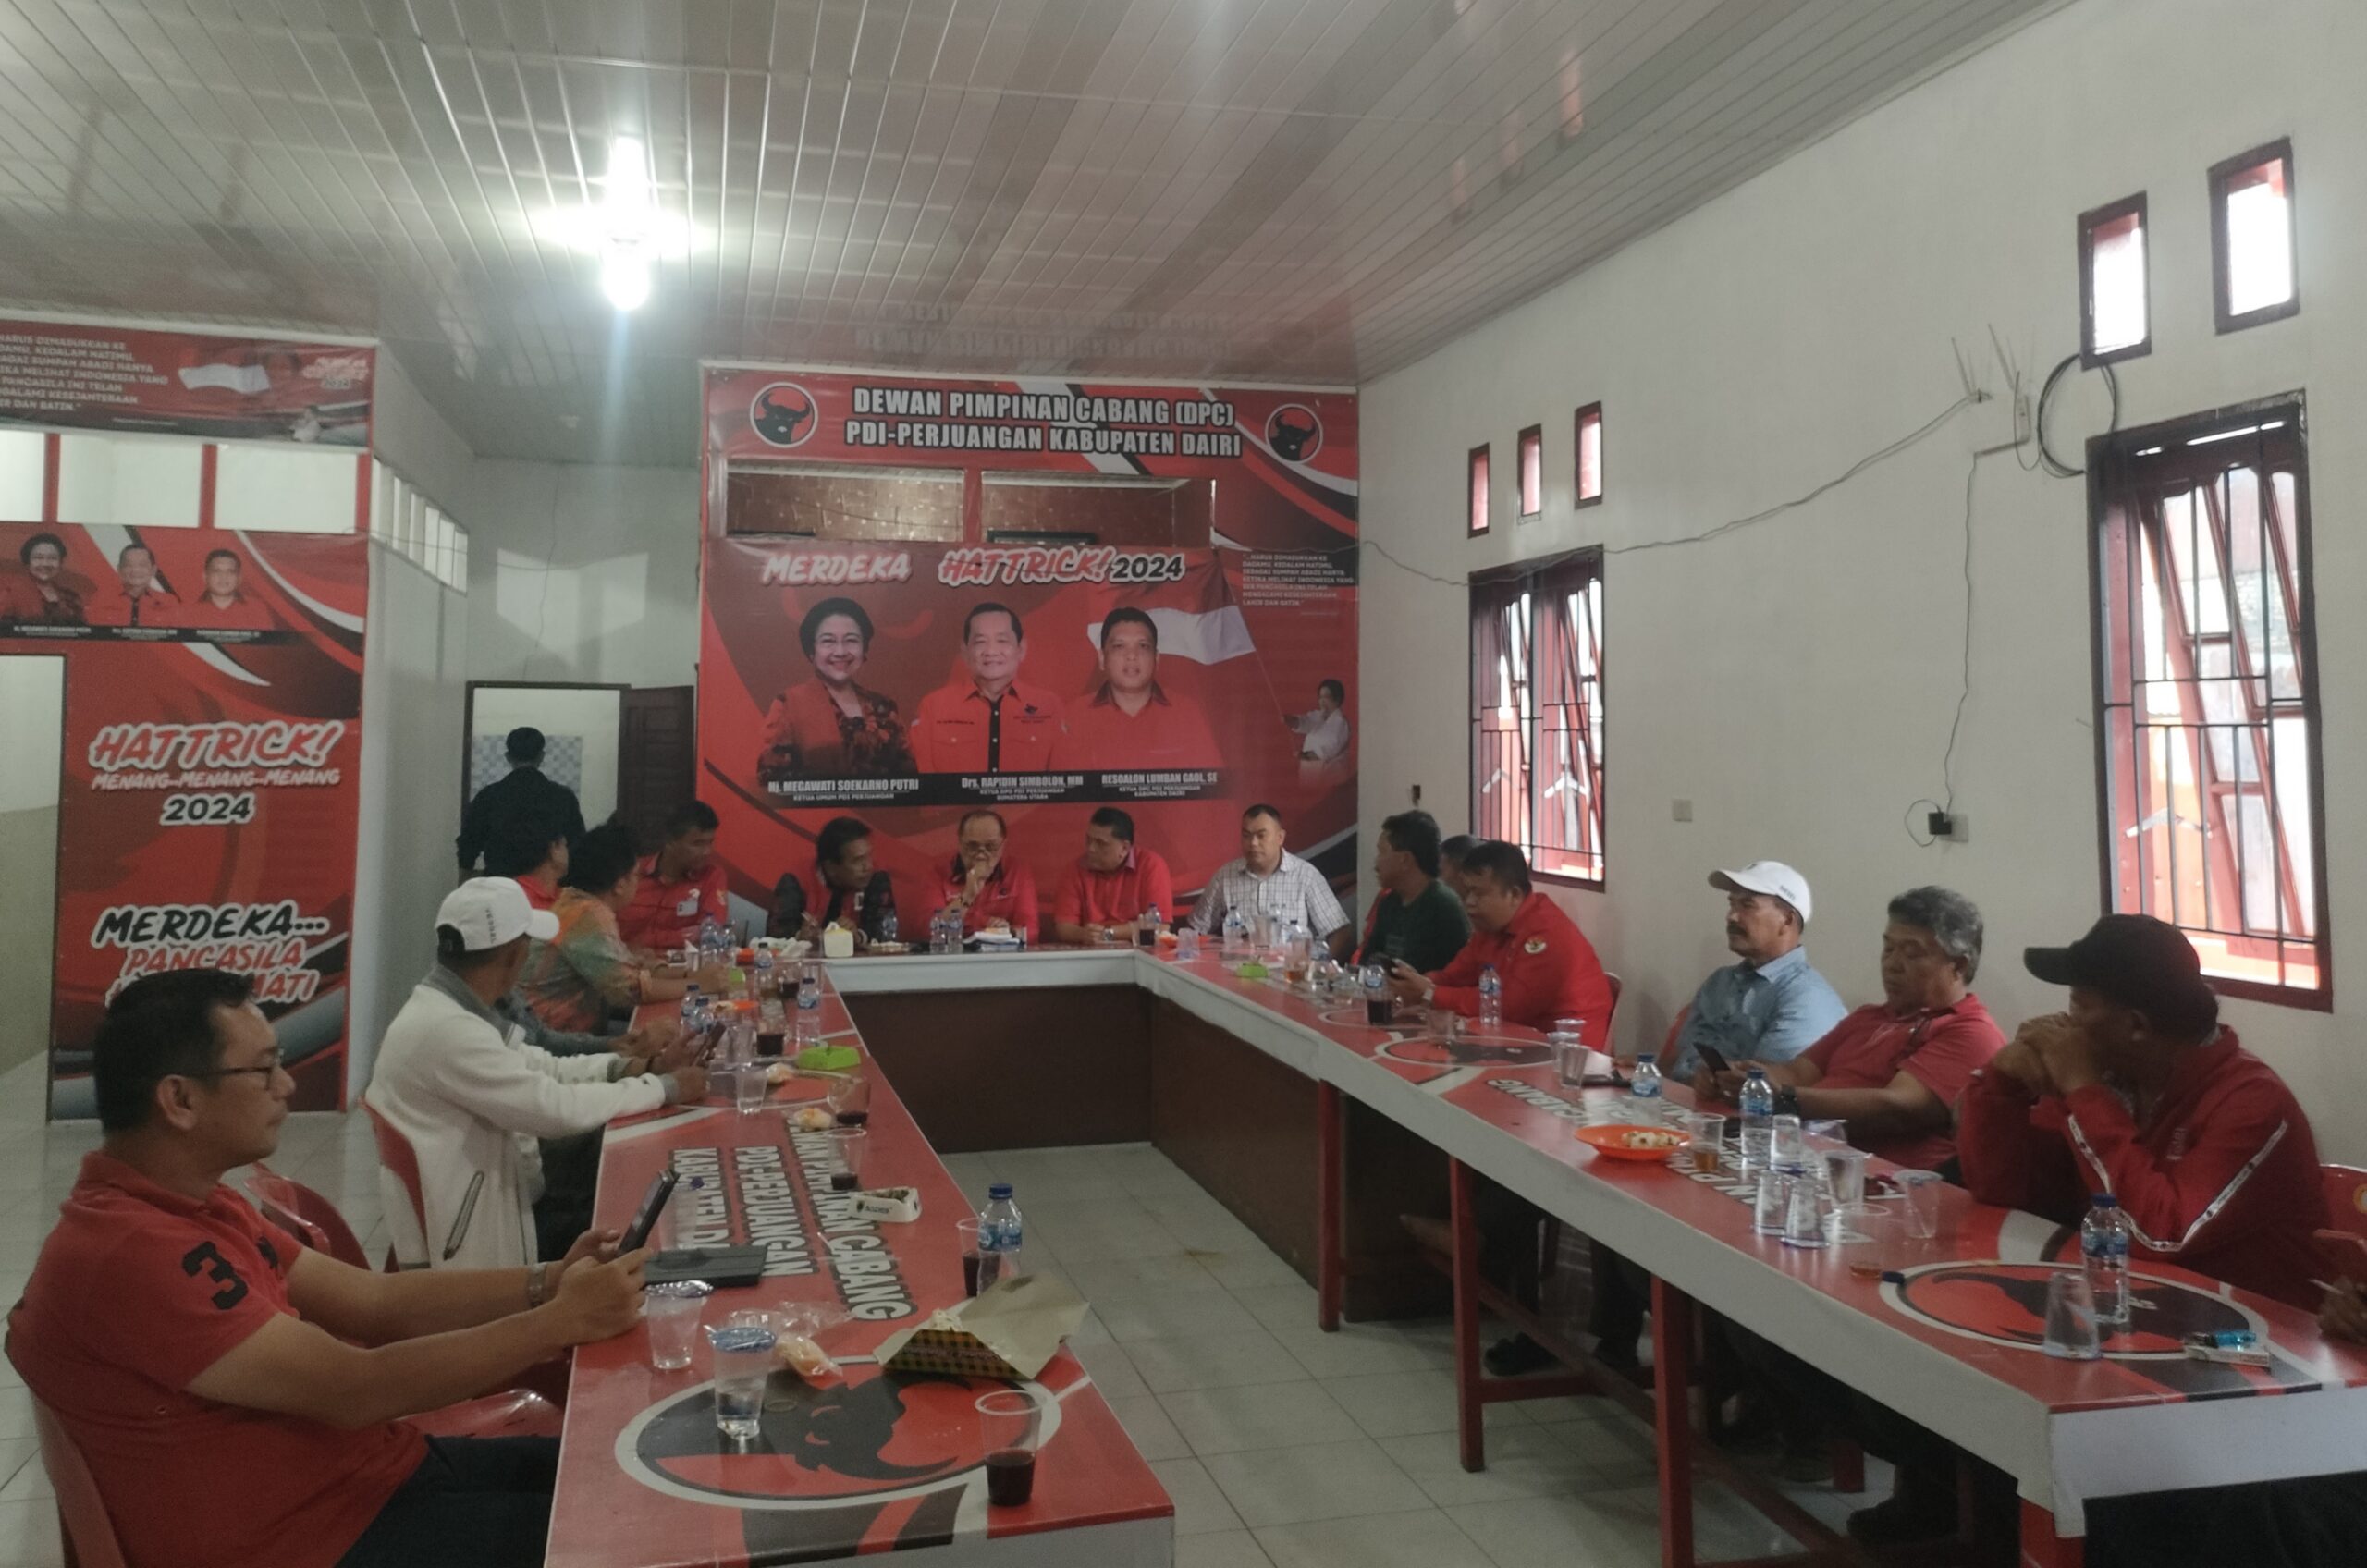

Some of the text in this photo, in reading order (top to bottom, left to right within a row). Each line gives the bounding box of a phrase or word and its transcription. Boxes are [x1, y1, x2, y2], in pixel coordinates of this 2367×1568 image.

[73, 370, 136, 382] INDONESIA
[853, 387, 1234, 427] DEWAN PIMPINAN CABANG (DPC)
[846, 420, 1241, 457] PDI-PERJUANGAN KABUPATEN DAIRI
[761, 553, 912, 585] MERDEKA
[938, 546, 1184, 586] HATTRICK! 2024
[89, 720, 345, 771] HATTRICK!
[783, 780, 836, 792] MEGAWATI
[837, 779, 889, 791] SOEKARNO
[889, 778, 919, 790] PUTRI
[981, 777, 1017, 787] RAPIDIN
[161, 793, 255, 825] 2024
[92, 900, 330, 949] MERDEKA...
[120, 937, 307, 978] PANCASILA
[181, 1241, 249, 1311] 3
[828, 1234, 912, 1321] CABANG
